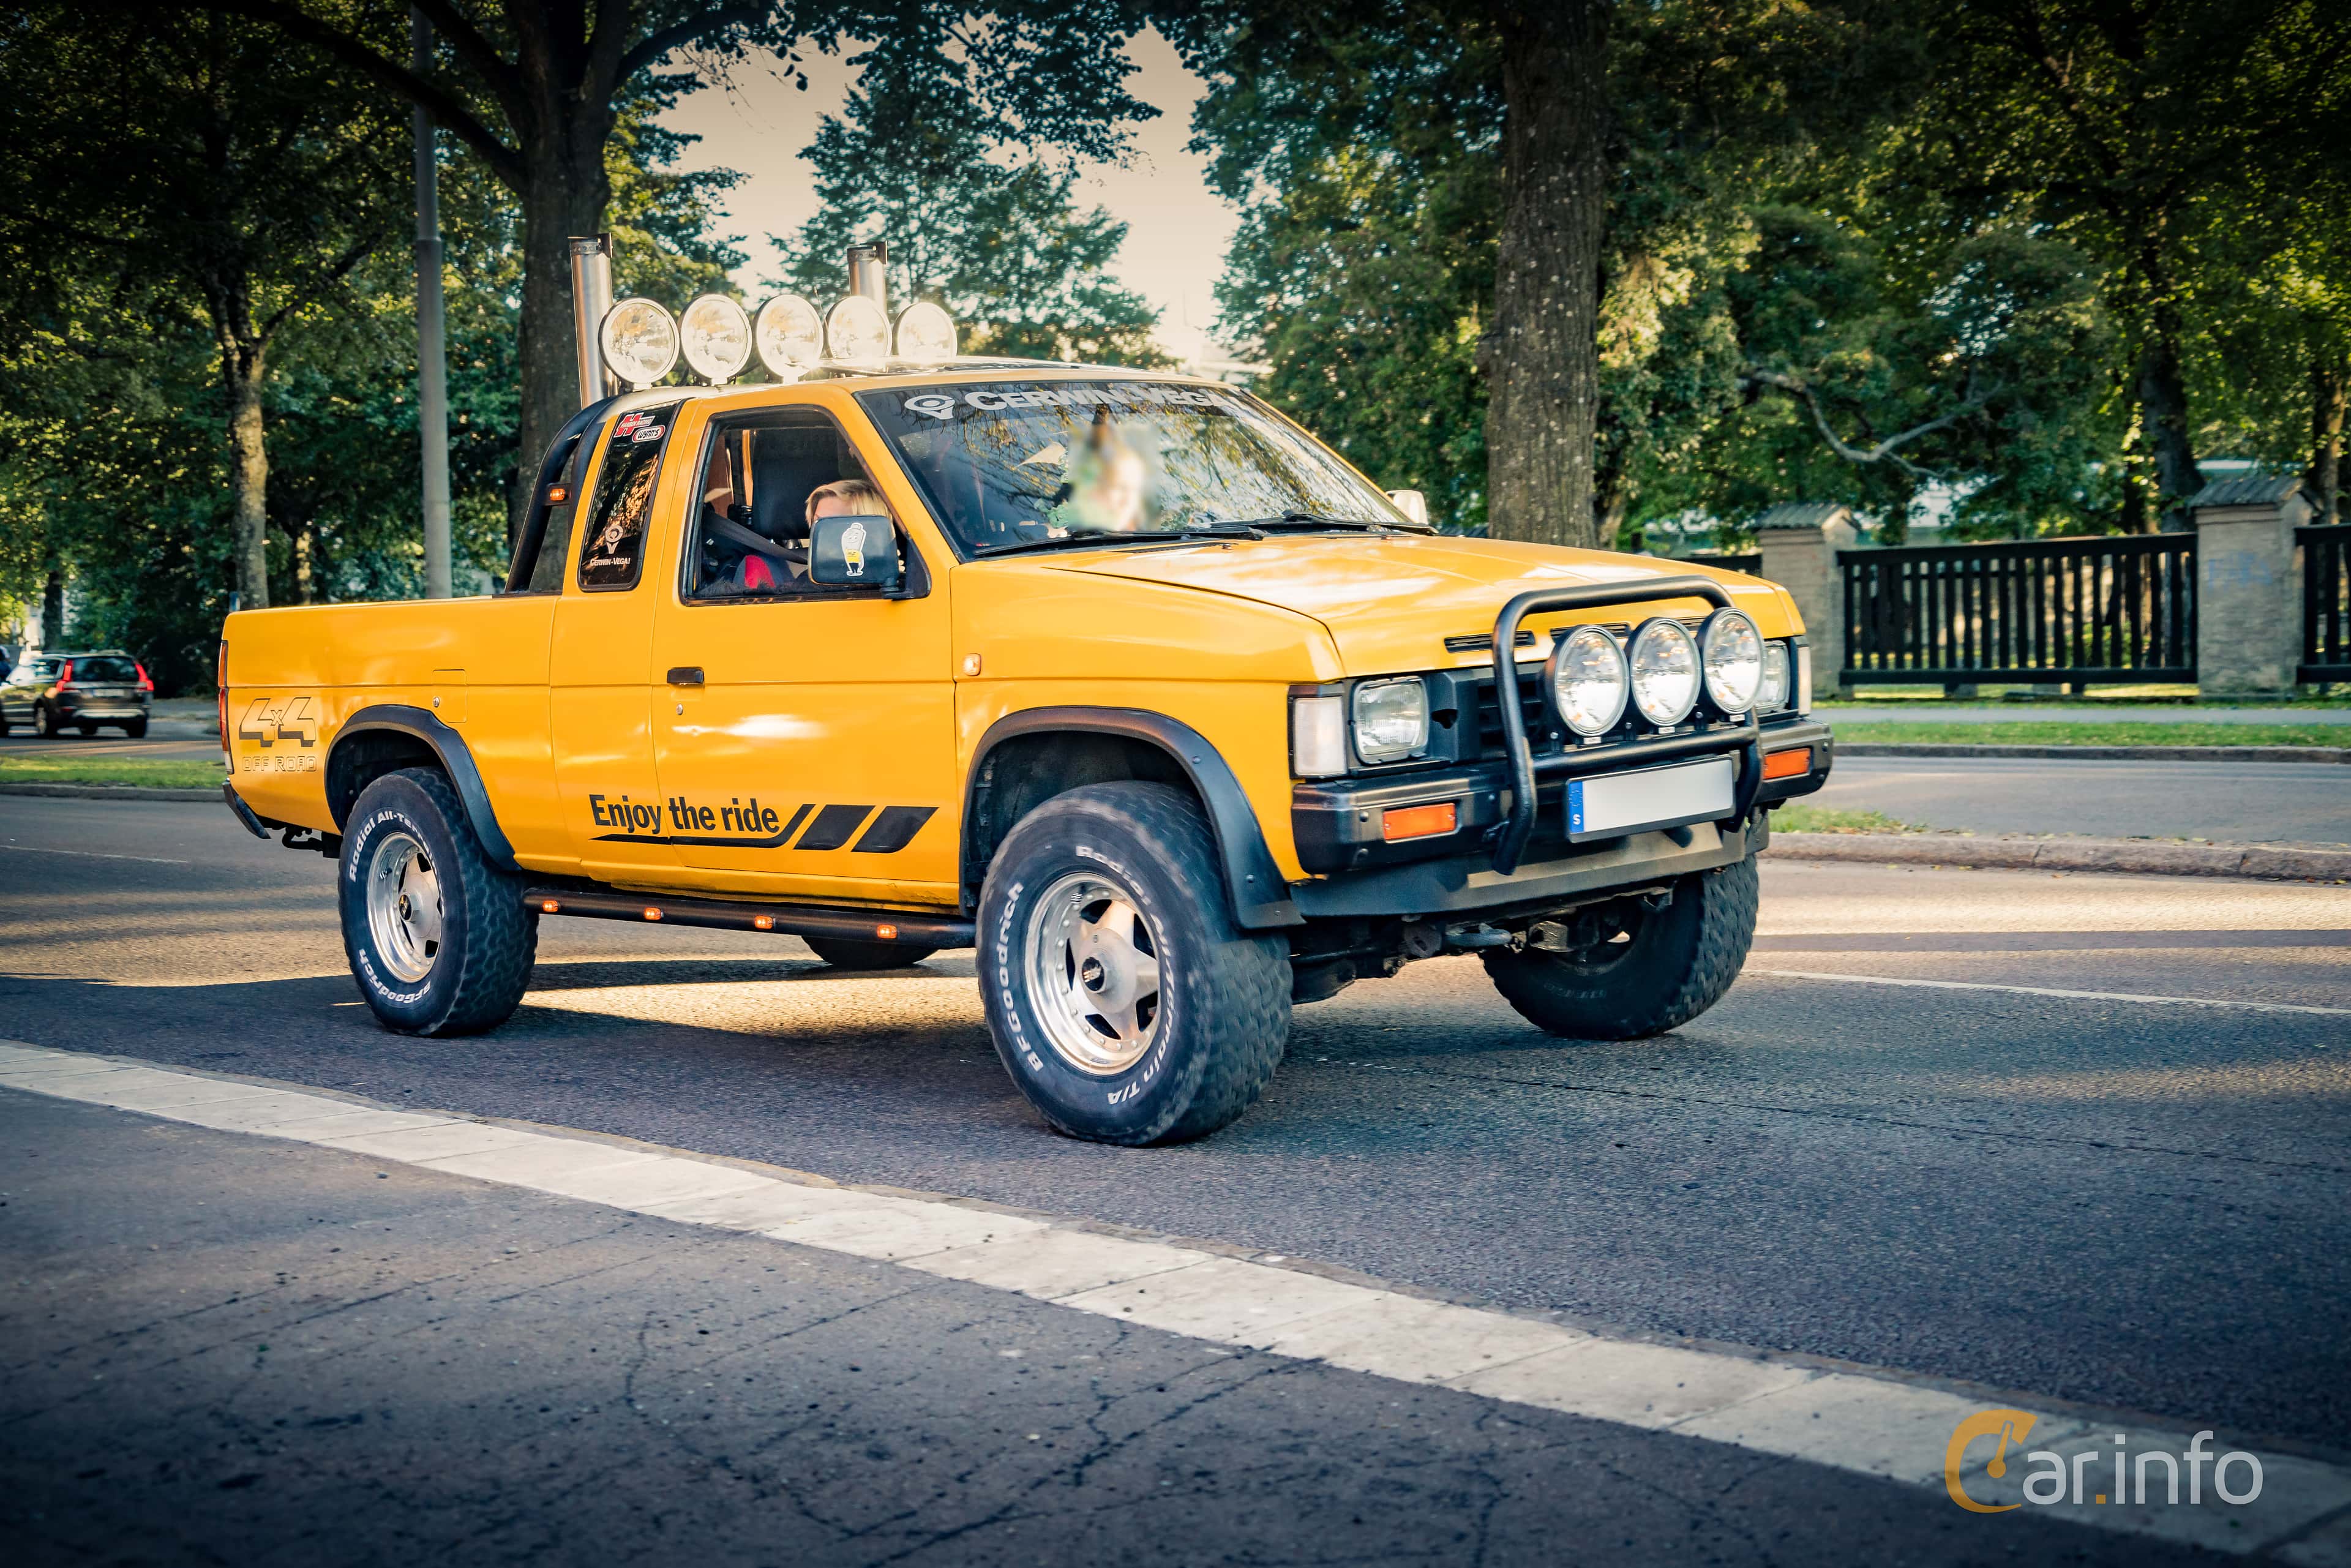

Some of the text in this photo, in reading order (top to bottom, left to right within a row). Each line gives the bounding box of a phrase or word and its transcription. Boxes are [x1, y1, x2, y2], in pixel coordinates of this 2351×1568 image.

[243, 756, 317, 771] OFF ROAD
[589, 794, 780, 834] Enjoy the ride
[1573, 814, 1581, 825] S
[349, 817, 377, 882] Radial
[996, 882, 1044, 1072] BFGoodrich
[1107, 1081, 1141, 1105] T/A
